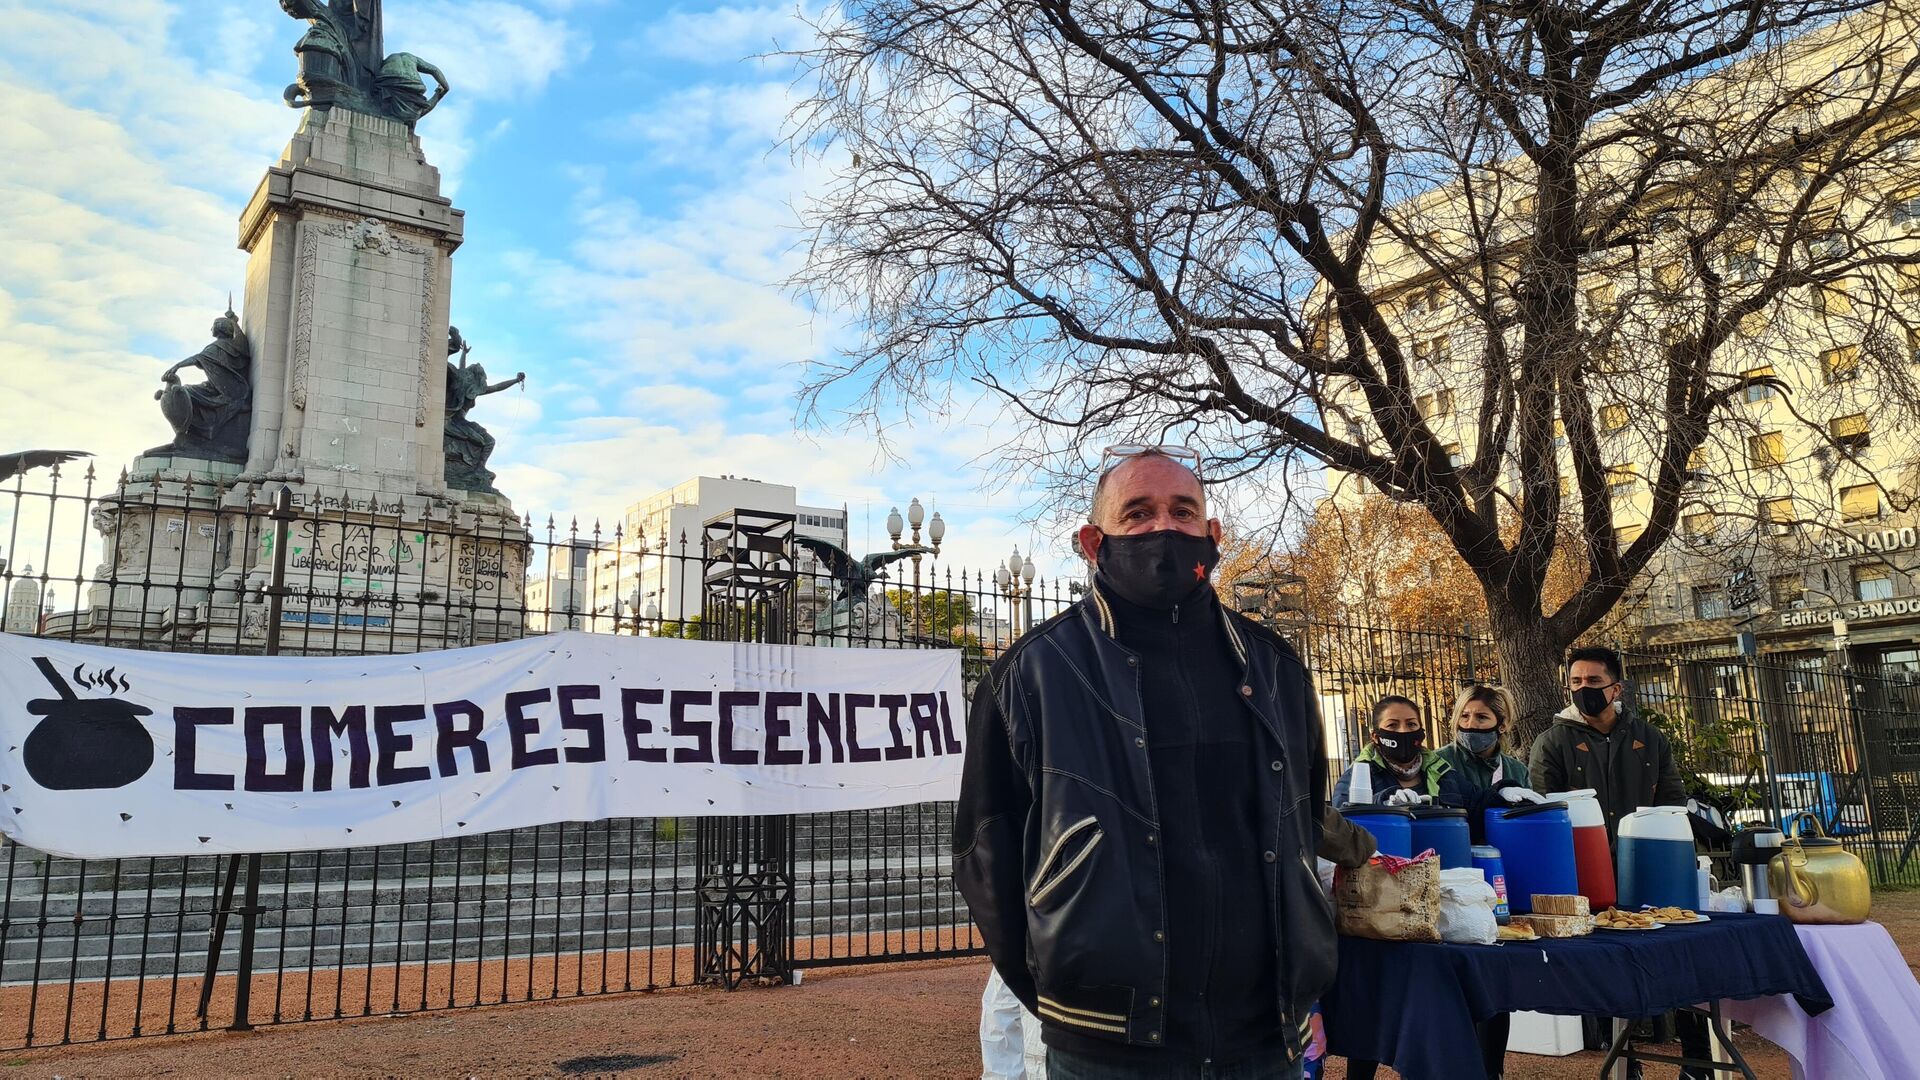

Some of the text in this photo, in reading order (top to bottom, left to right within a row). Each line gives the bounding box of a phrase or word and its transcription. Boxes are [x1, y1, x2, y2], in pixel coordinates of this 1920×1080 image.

[291, 494, 312, 506] EL
[298, 521, 330, 538] SE
[1820, 527, 1917, 559] SENADO
[1781, 598, 1920, 626] Edificio SENADO
[173, 684, 962, 792] COMER ES ESCENCIAL
